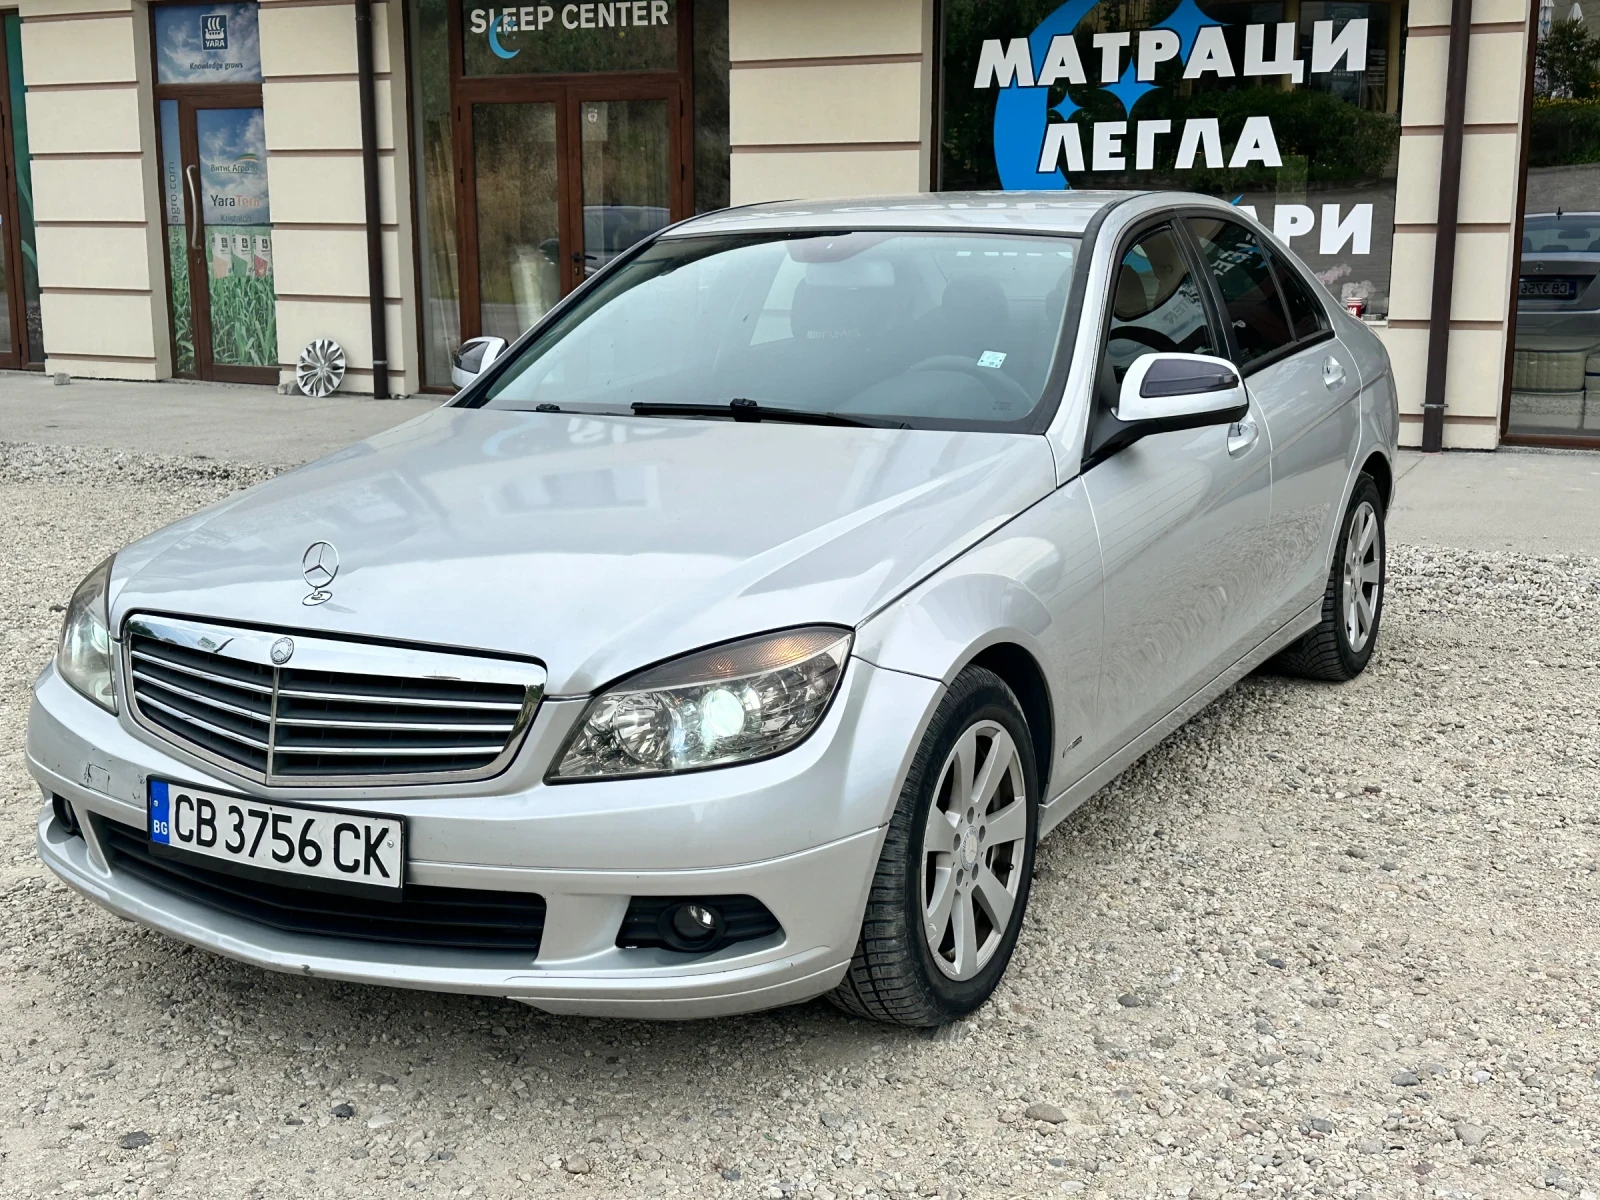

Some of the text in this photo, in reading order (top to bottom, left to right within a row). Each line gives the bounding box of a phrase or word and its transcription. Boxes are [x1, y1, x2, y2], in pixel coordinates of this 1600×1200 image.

[470, 0, 669, 34] SLEEP CENTER
[205, 39, 225, 48] YARA
[974, 18, 1368, 89] МАТРАЦИ
[189, 62, 243, 71] Knowledge grows
[1038, 116, 1283, 173] ЛЕГЛА
[153, 819, 168, 836] BG
[174, 794, 390, 878] CB 3756 CK
